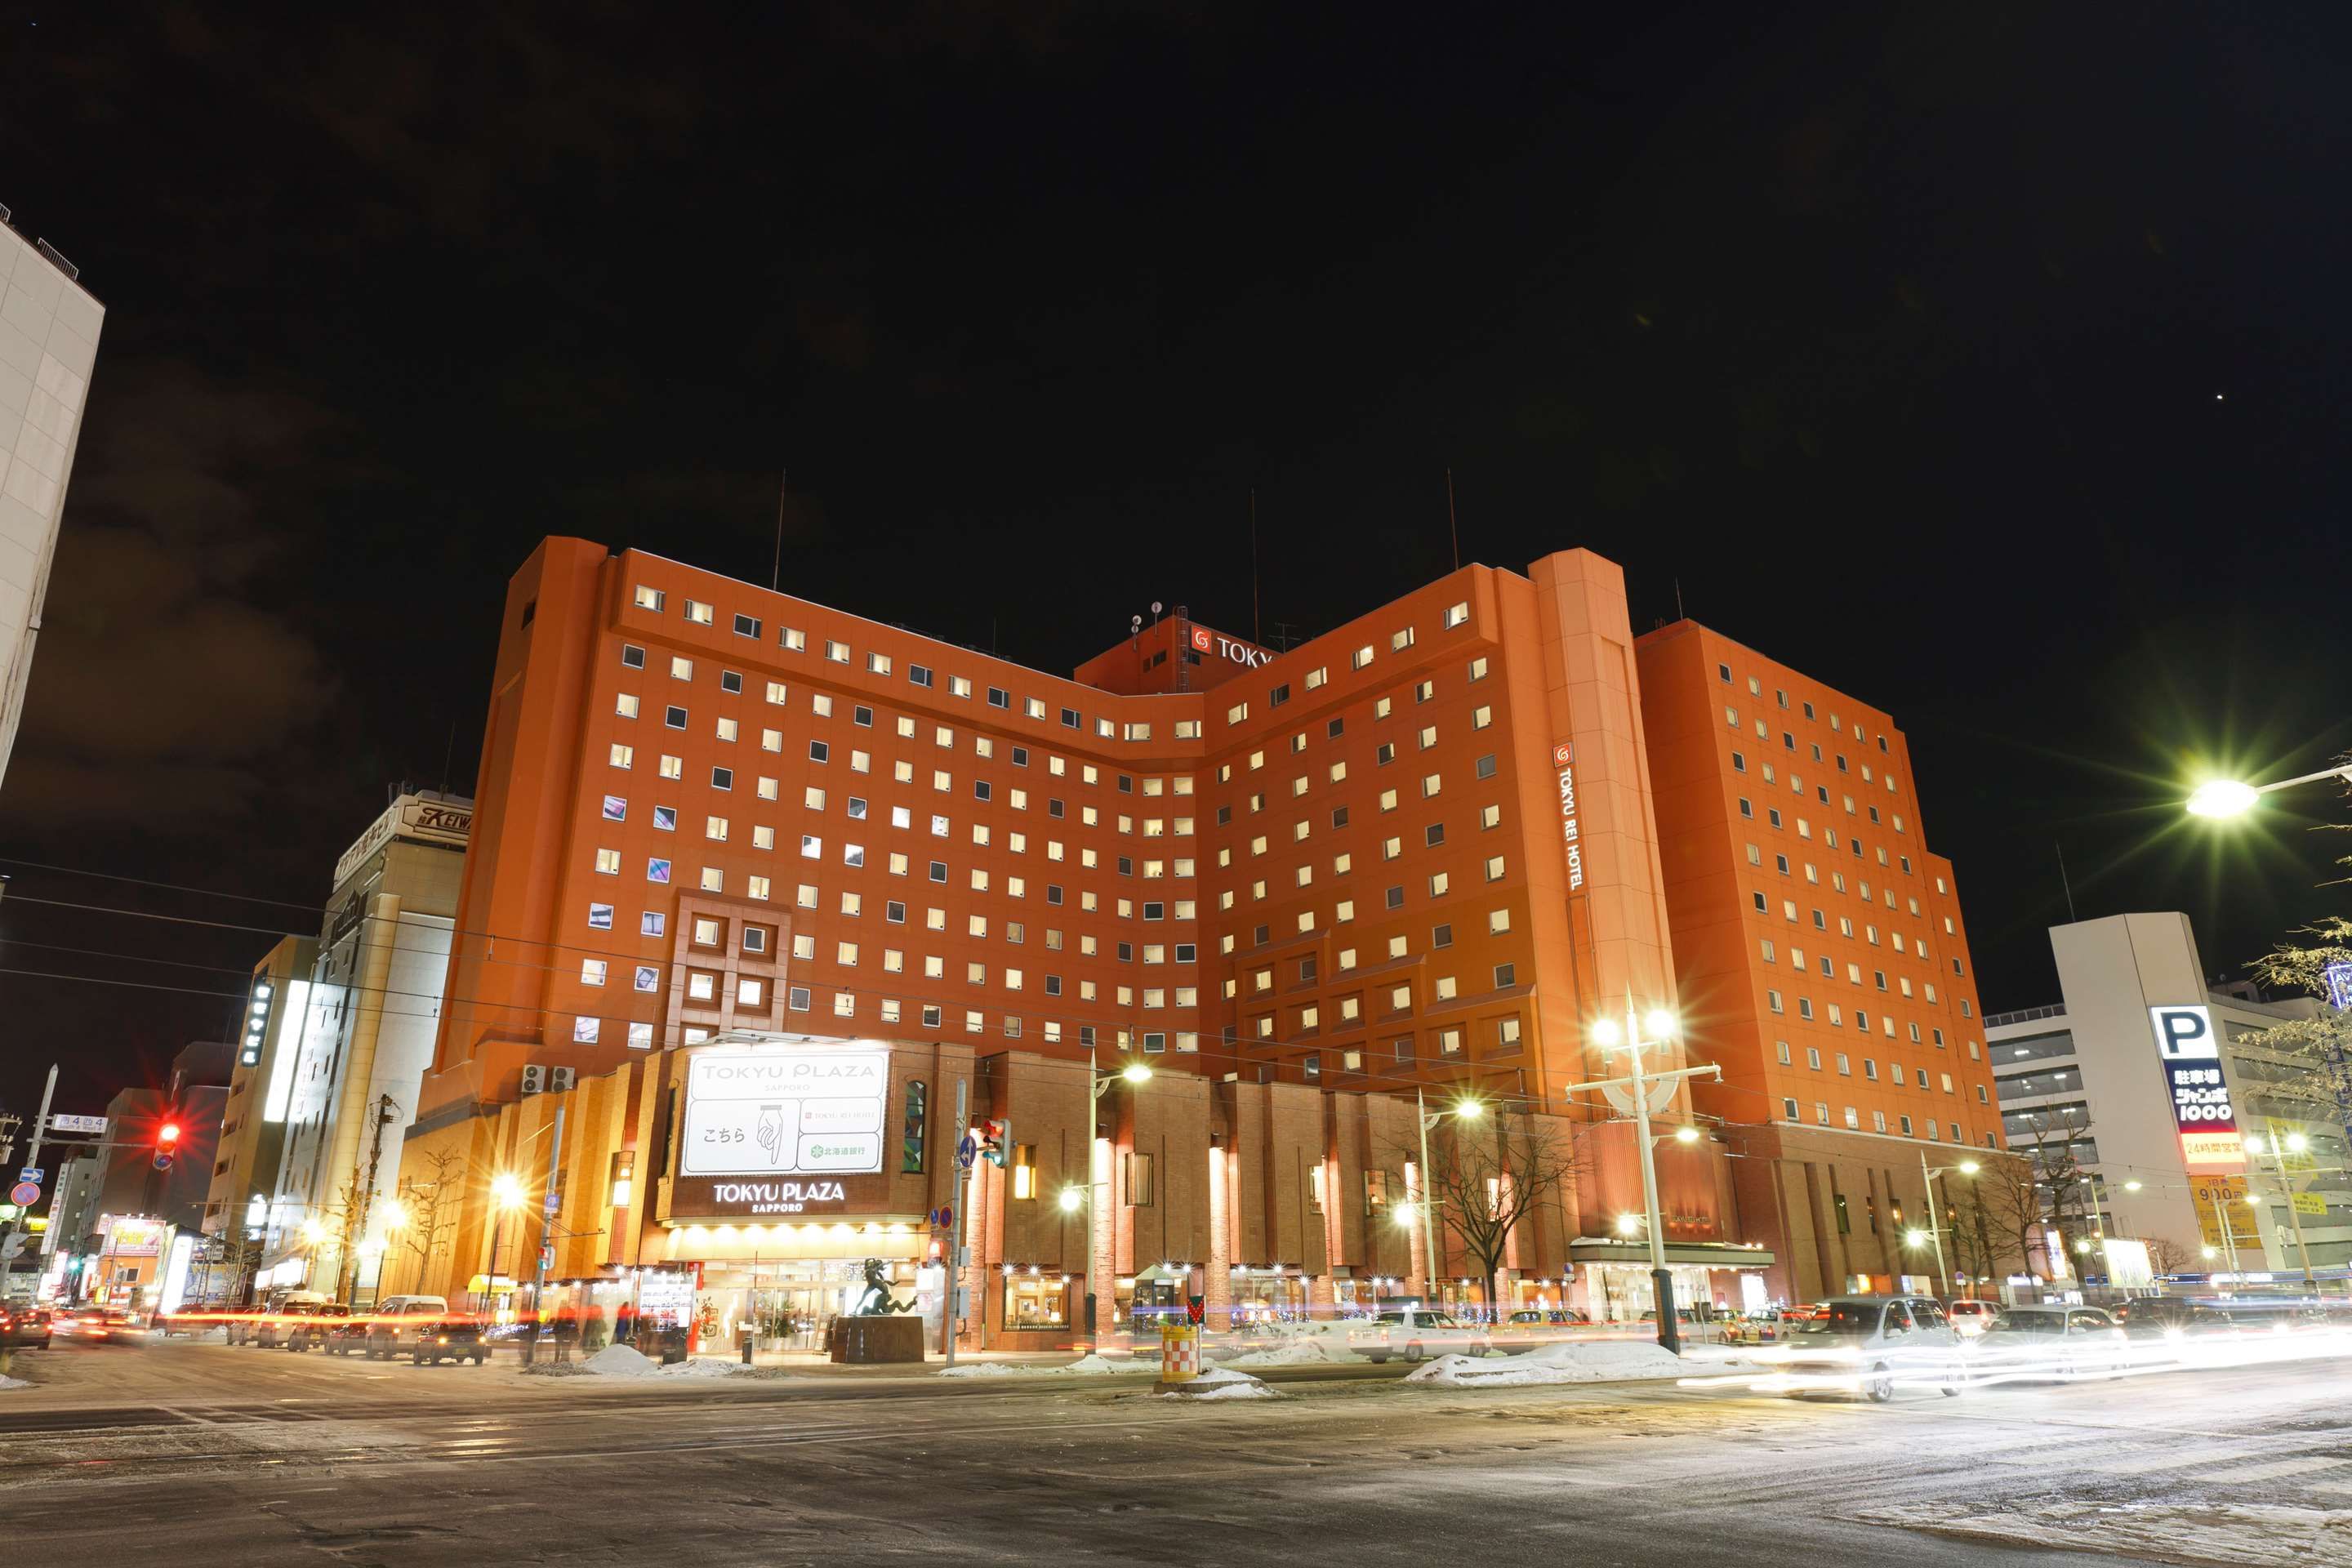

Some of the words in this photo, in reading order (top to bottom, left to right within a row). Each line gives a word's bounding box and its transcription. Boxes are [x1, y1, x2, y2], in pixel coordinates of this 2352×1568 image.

[1559, 768, 1575, 816] TOKYU
[422, 808, 472, 830] KEIW
[1565, 819, 1578, 841] REI
[1568, 844, 1583, 891] HOTEL
[2160, 1011, 2206, 1054] P
[703, 1065, 783, 1080] TOKYU
[793, 1063, 875, 1078] PLAZA
[2174, 1069, 2221, 1085] 駐車場
[765, 1084, 810, 1092] SAPPORO
[2175, 1087, 2229, 1104] ジャンボ
[2180, 1104, 2233, 1121] 1000
[703, 1127, 746, 1144] こちら
[823, 1146, 866, 1156] 北海道銀行
[2187, 1143, 2243, 1155] 24時間営業
[713, 1183, 779, 1203] TOKYU
[782, 1182, 845, 1202] PLAZA
[751, 1203, 804, 1214] SAPPORO
